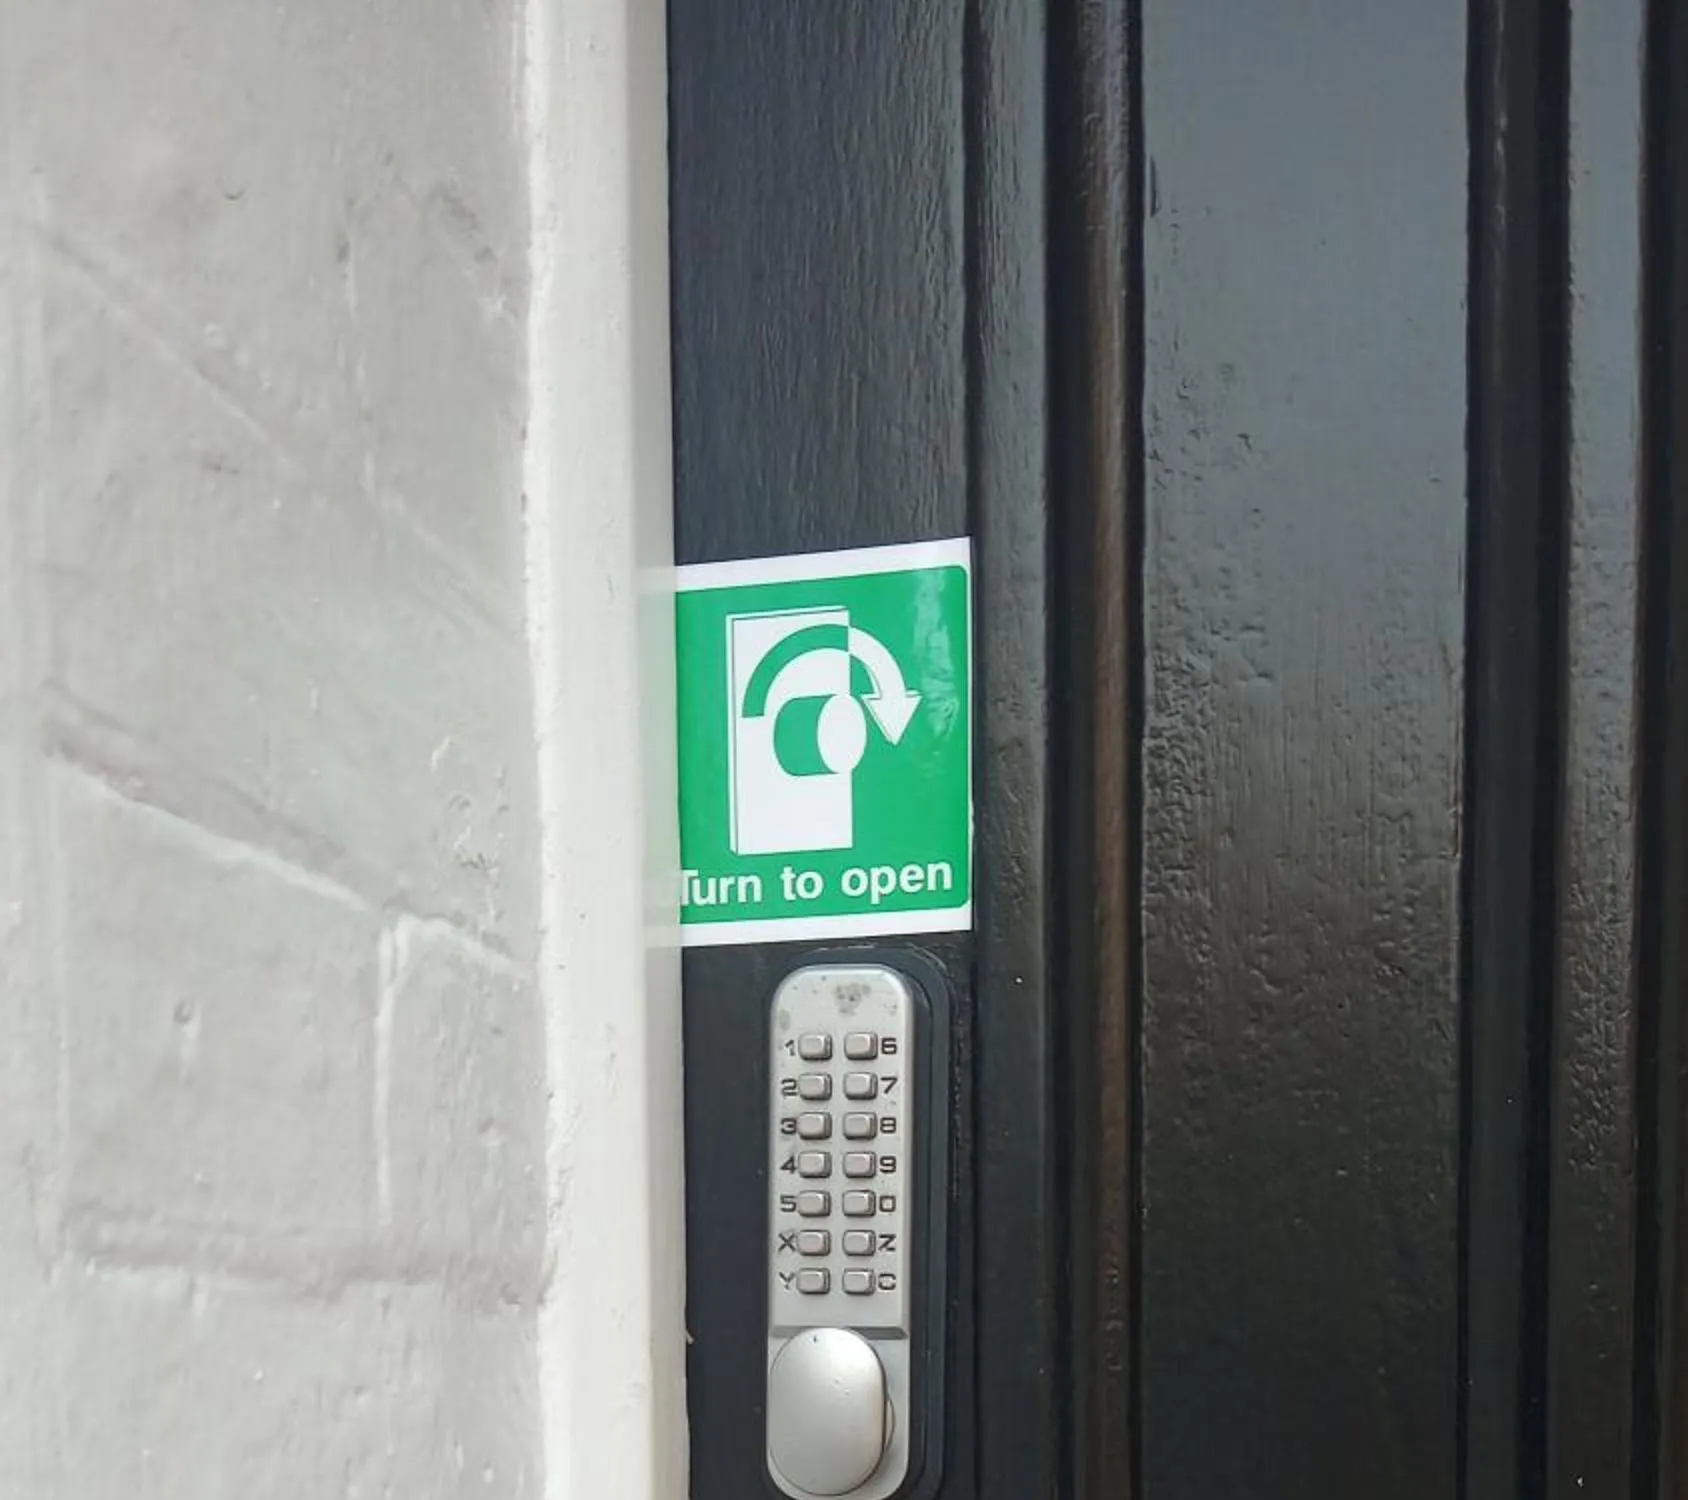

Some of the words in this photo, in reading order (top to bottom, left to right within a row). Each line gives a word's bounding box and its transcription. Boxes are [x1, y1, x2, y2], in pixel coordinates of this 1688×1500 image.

[680, 868, 763, 906] Turn
[780, 866, 824, 901] to
[841, 860, 953, 905] open
[785, 1040, 795, 1056] 1
[881, 1037, 897, 1055] 6
[781, 1078, 797, 1096] 2
[880, 1076, 897, 1094] 7
[781, 1118, 797, 1135] 3
[880, 1117, 896, 1134] 8
[780, 1155, 797, 1174] 4
[880, 1156, 896, 1174] 9
[780, 1195, 797, 1213] 5
[778, 1232, 796, 1253] X
[879, 1233, 897, 1251] Z
[779, 1271, 795, 1290] Y
[878, 1273, 896, 1291] C
